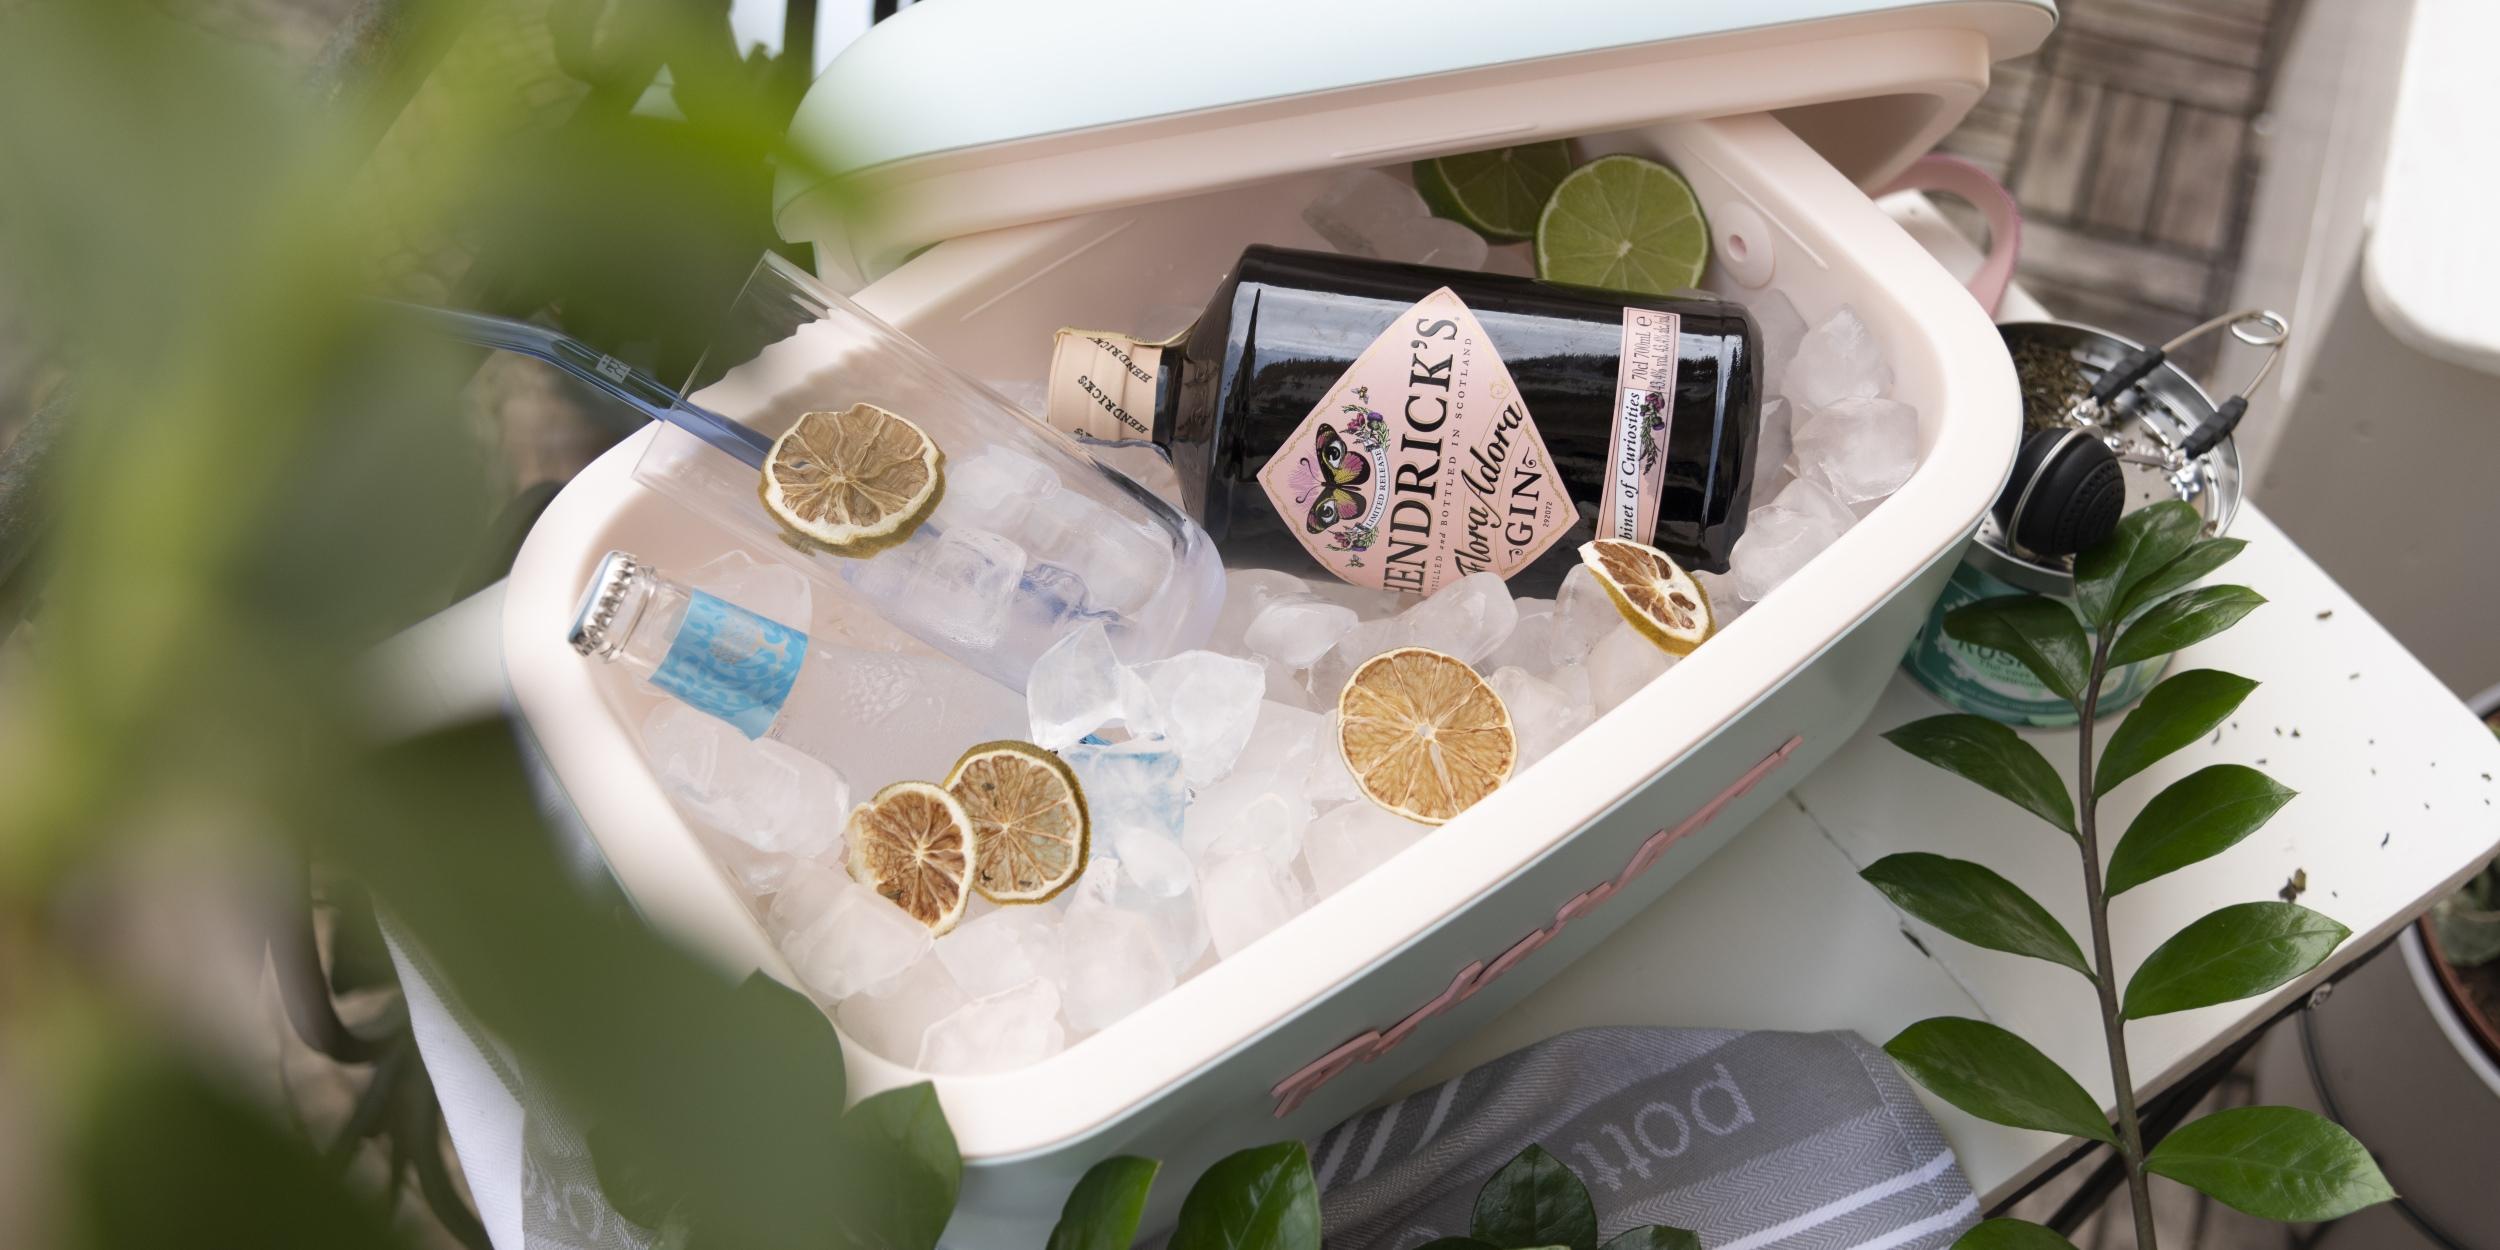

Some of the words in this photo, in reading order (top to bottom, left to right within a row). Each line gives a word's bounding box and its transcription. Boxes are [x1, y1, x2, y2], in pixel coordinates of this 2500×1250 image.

[1631, 361, 1649, 380] 70cl
[1077, 375, 1149, 434] HENDRICK'S
[1440, 456, 1457, 526] BOTTLED
[1452, 429, 1460, 446] IN
[1456, 338, 1472, 419] SCOTLAND
[1622, 392, 1641, 476] Curiosities
[1375, 449, 1387, 491] RELEASE
[1383, 318, 1458, 592] HENDRICK'S
[1461, 401, 1523, 528] Adora
[1366, 494, 1385, 527] LIMITED
[1505, 467, 1542, 546] GIN
[1543, 501, 1553, 528] 292072
[1620, 480, 1638, 498] of
[1454, 506, 1492, 576] Flora
[1619, 505, 1635, 540] binet
